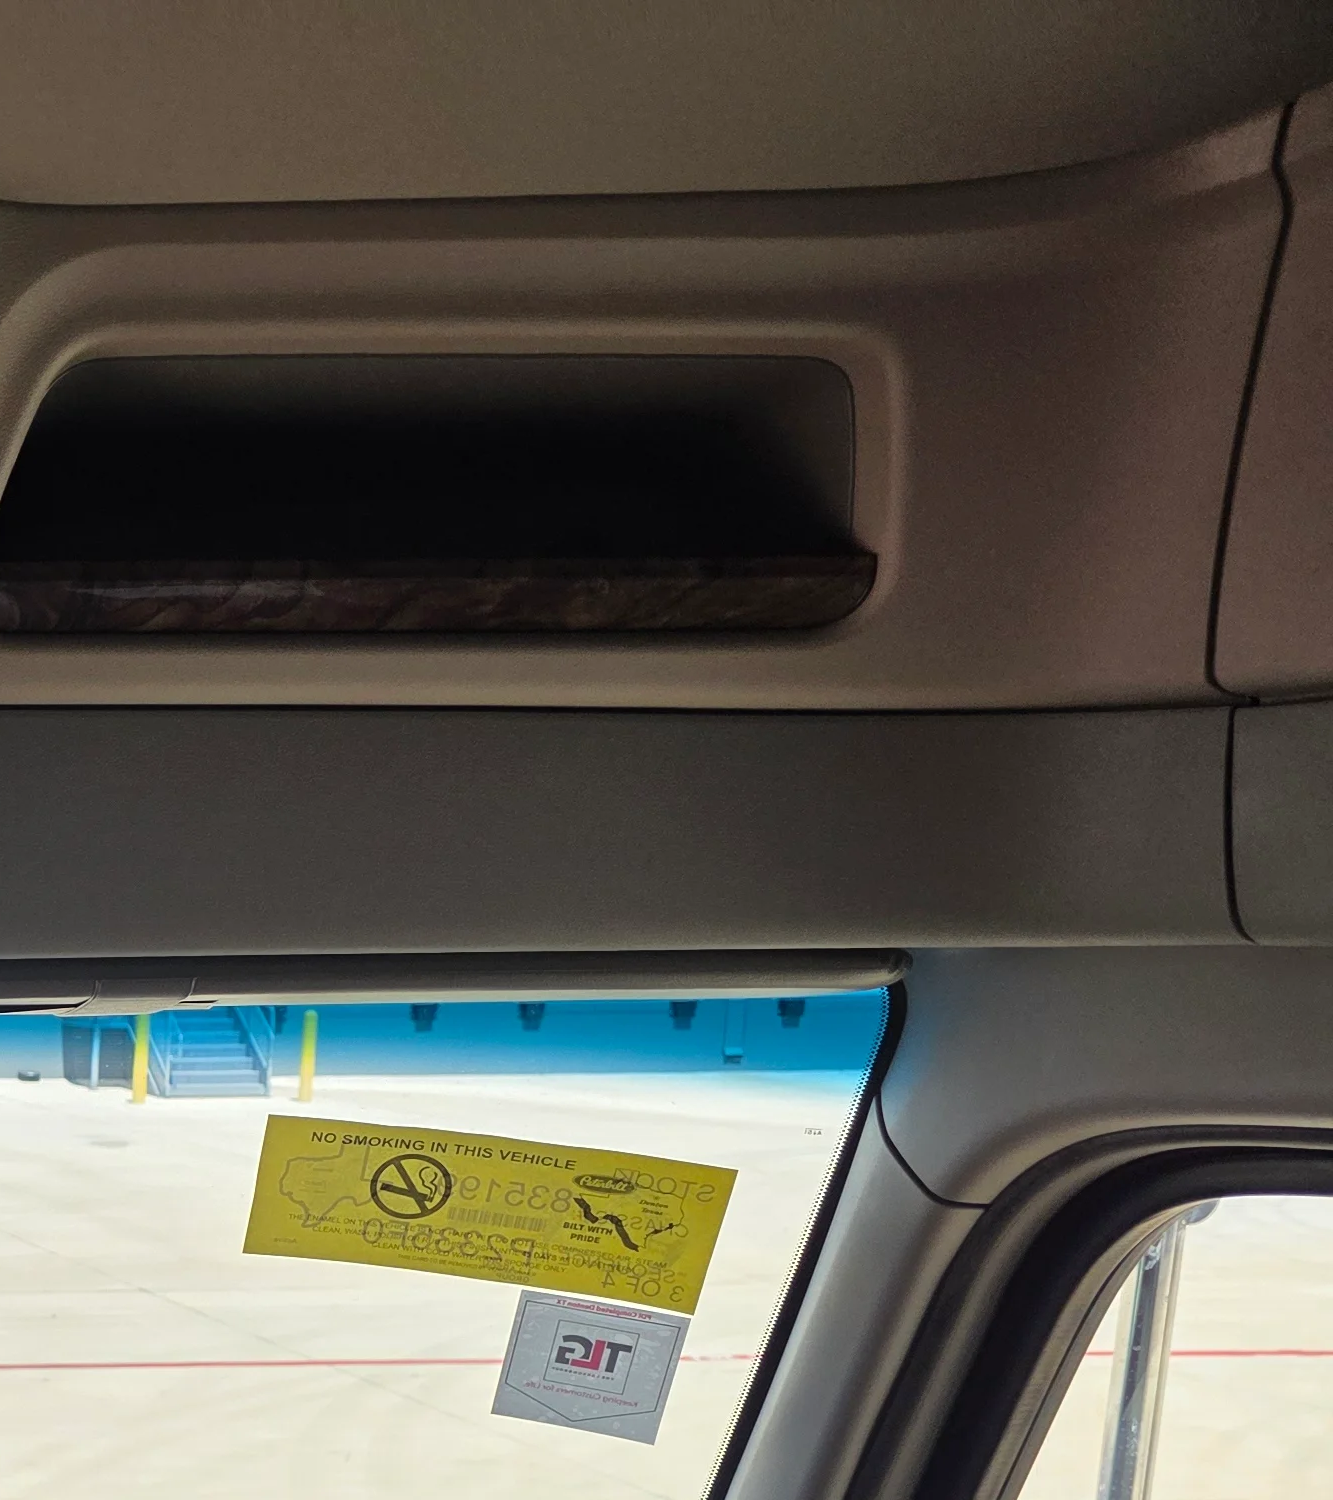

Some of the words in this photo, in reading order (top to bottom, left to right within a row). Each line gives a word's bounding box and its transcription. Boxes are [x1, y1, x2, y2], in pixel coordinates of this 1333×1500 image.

[311, 1132, 336, 1144] NO
[342, 1134, 425, 1151] SMOKING
[431, 1142, 447, 1153] IN
[455, 1144, 493, 1159] THIS
[499, 1149, 577, 1171] VEHICLE
[580, 1176, 628, 1191] Peterbilt
[563, 1221, 585, 1231] BILT
[587, 1225, 613, 1236] WITH
[570, 1233, 601, 1244] PRIDE
[534, 1252, 557, 1261] DAYS
